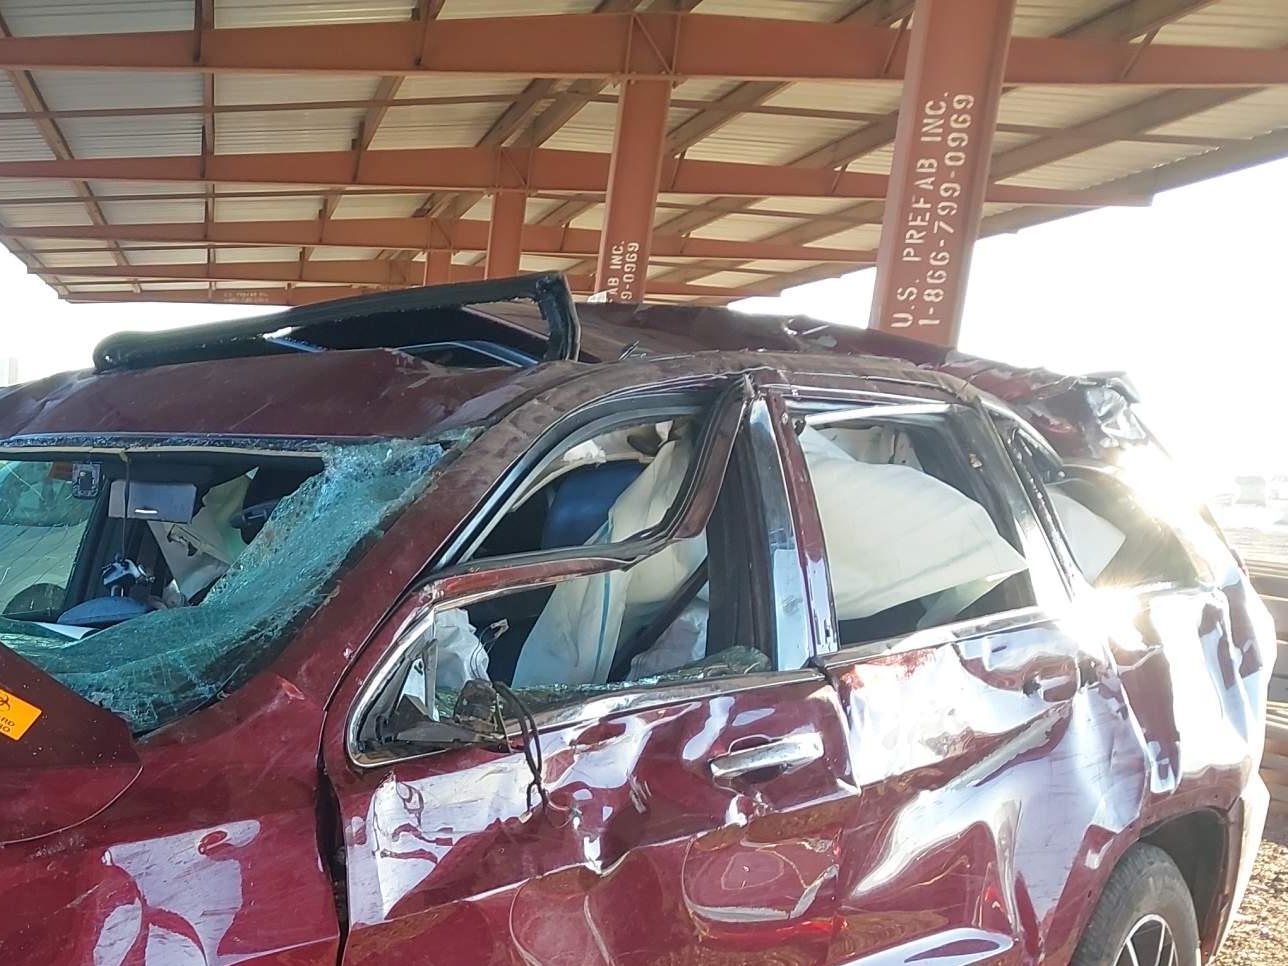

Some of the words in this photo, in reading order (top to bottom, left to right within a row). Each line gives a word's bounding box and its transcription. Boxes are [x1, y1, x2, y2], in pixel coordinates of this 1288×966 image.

[920, 91, 950, 142] INC.
[902, 157, 938, 262] PREFAB
[918, 93, 975, 327] 1-866-799-0969
[609, 240, 625, 270] INC.
[890, 279, 921, 328] U.S.
